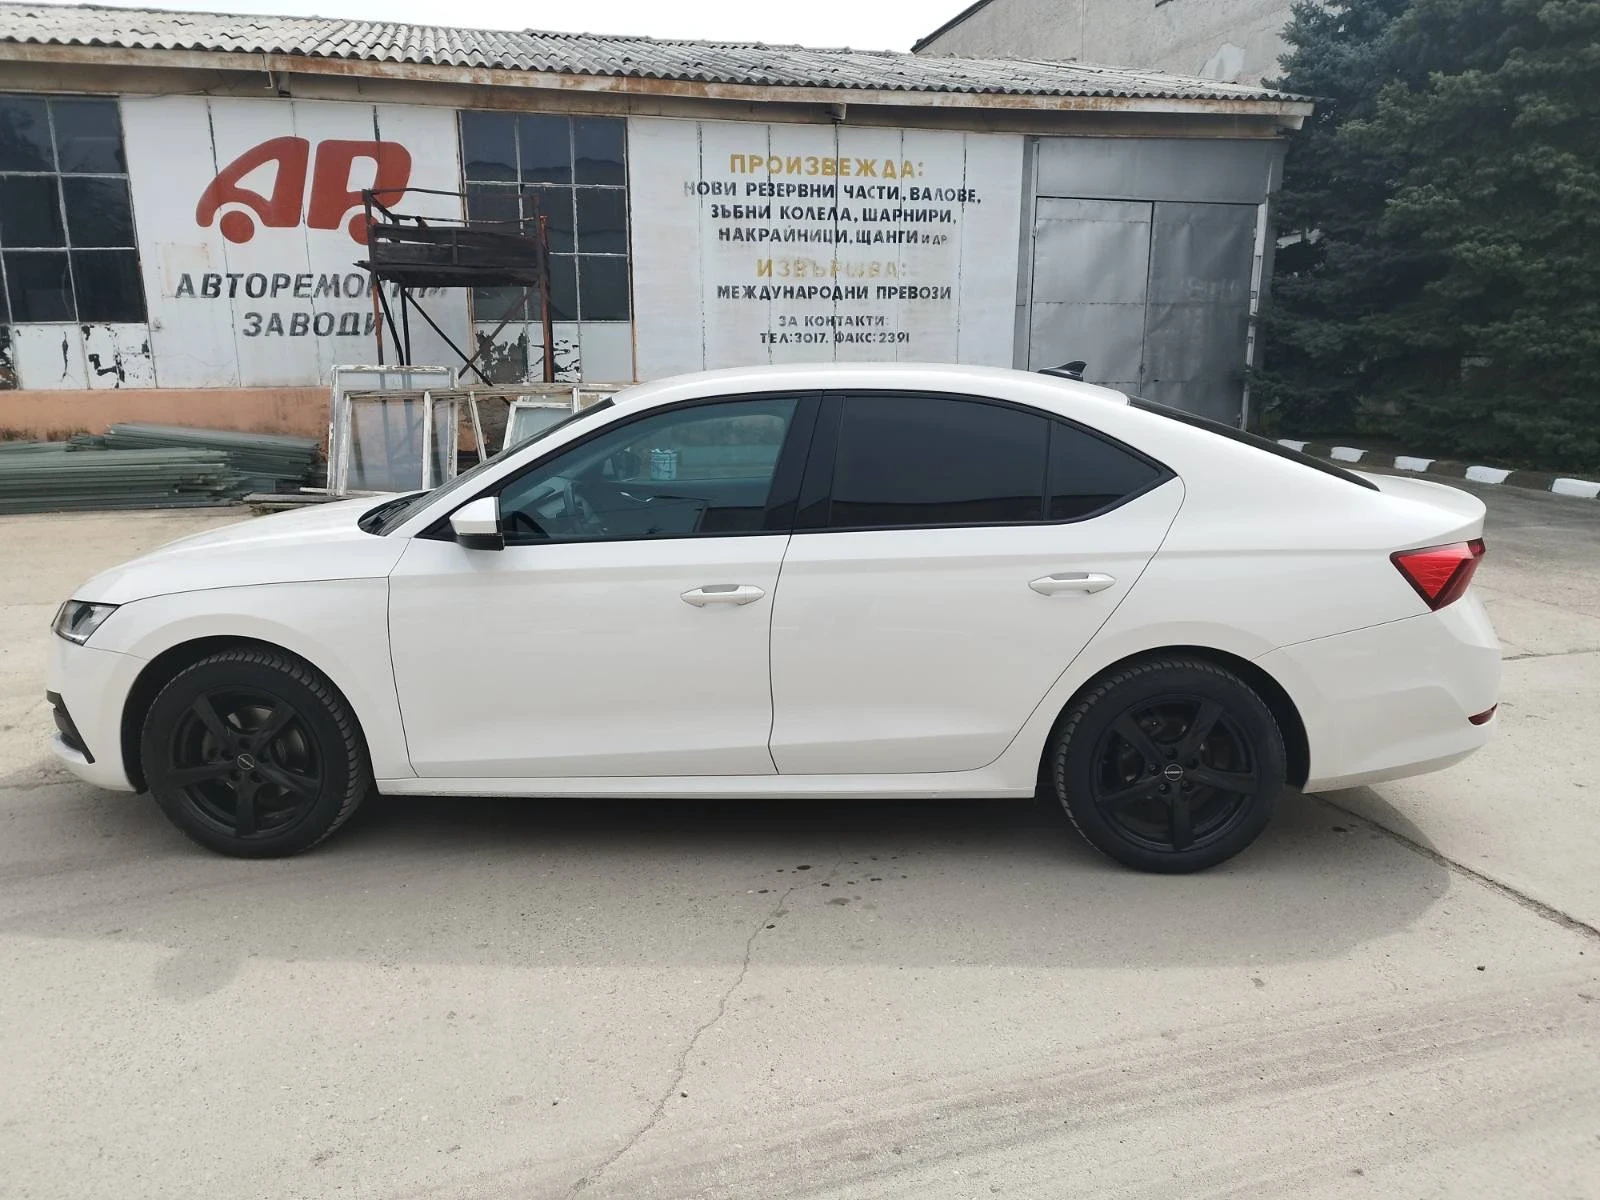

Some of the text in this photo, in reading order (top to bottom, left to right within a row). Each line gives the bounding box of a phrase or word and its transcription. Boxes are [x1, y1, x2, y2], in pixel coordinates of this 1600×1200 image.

[730, 153, 924, 180] ПРОИЗВЕЖДА:
[684, 181, 981, 204] НОВИ РЕЗЕРВНИ ЧАСТИ, ВАЛОВЕ,
[711, 204, 957, 224] ЗЪБНИ КОЛЕЛА, ШАРНИРИ,
[856, 229, 918, 245] ЩАНГИ
[175, 272, 447, 299] АВТОРЕМО
[717, 285, 951, 301] МЕЖДУНАРОДНИ ПРЕВОЗИ
[243, 311, 384, 337] ЗАВОДИ
[779, 315, 889, 327] ЗА КОНТАКТИ:
[835, 331, 910, 344] ФАКС:2391
